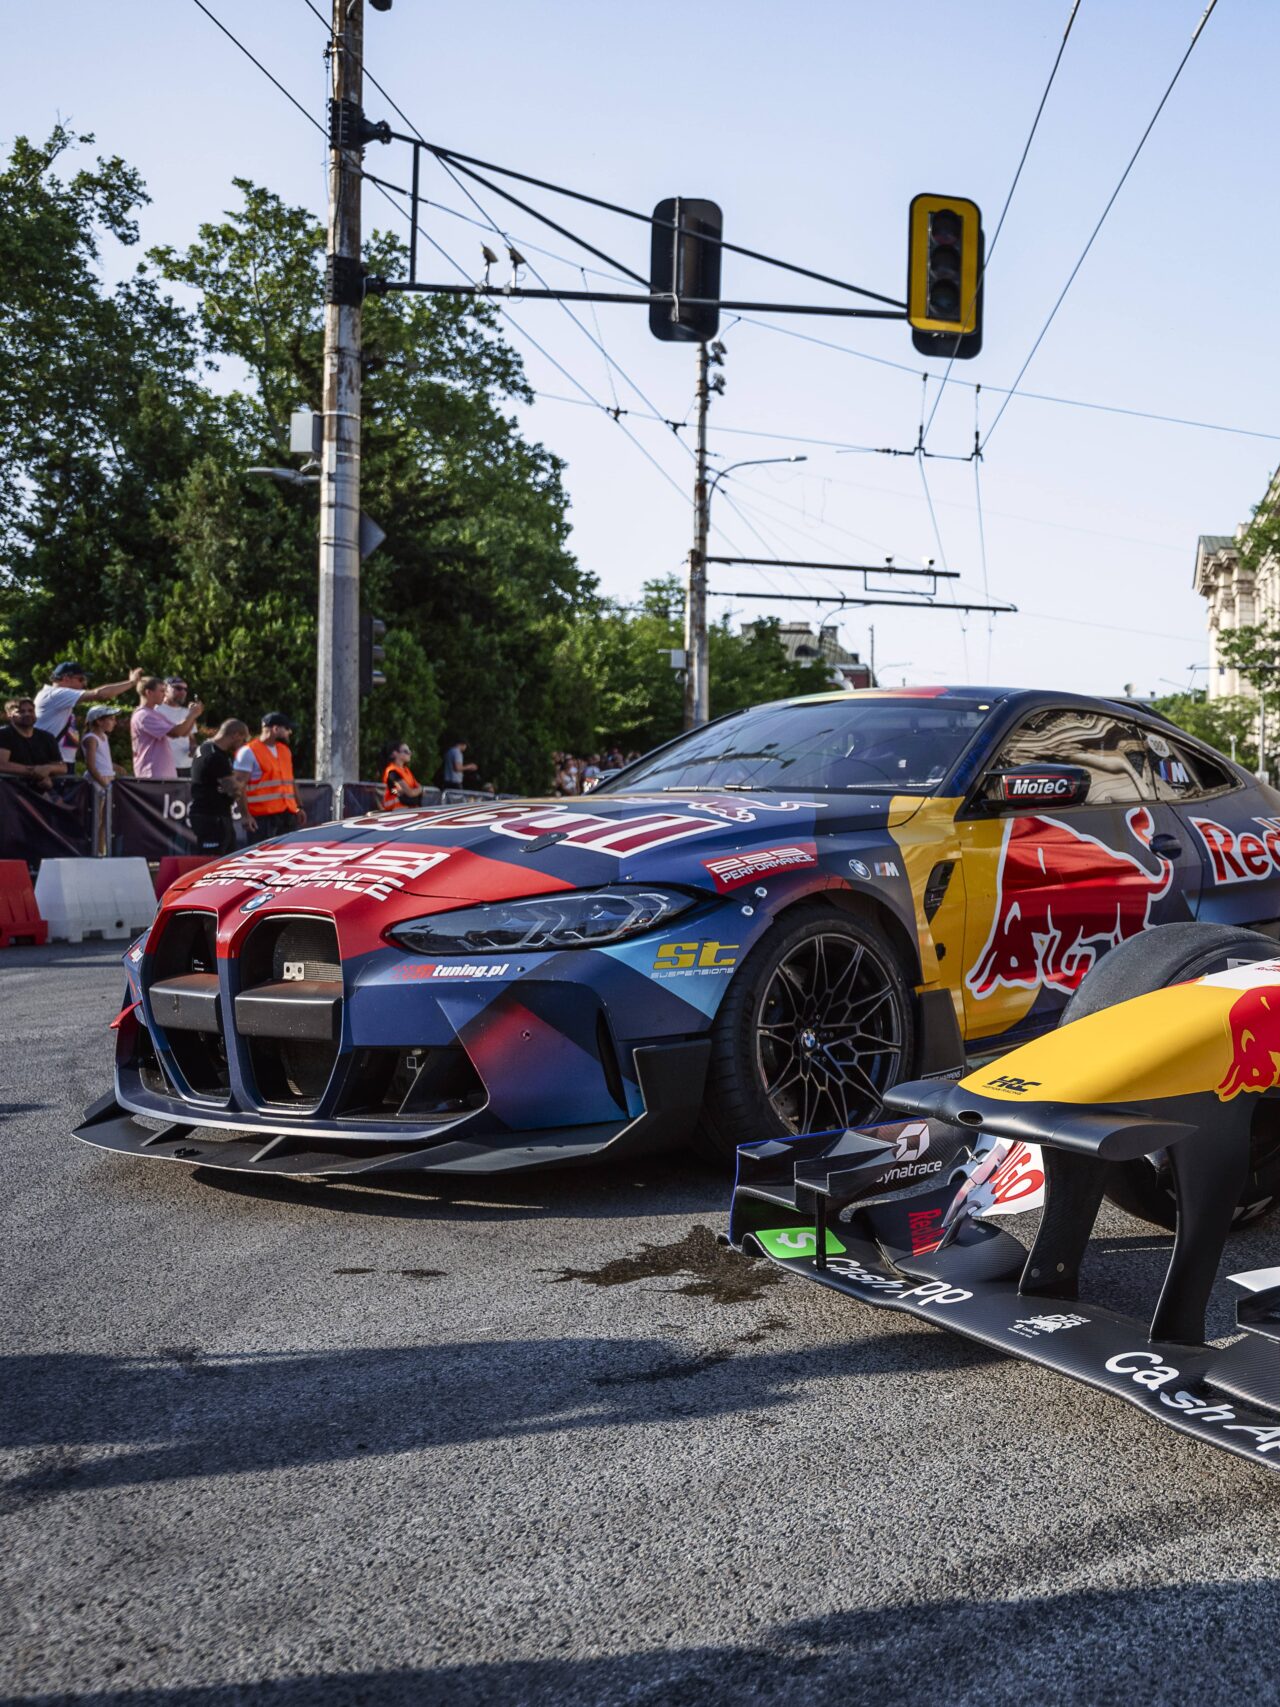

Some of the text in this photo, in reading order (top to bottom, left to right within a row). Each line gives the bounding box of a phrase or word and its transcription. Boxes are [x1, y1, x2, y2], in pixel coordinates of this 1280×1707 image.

[1013, 778, 1068, 795] MoTeC
[720, 854, 815, 883] PERFORMANCE
[1104, 1351, 1236, 1422] Cash
